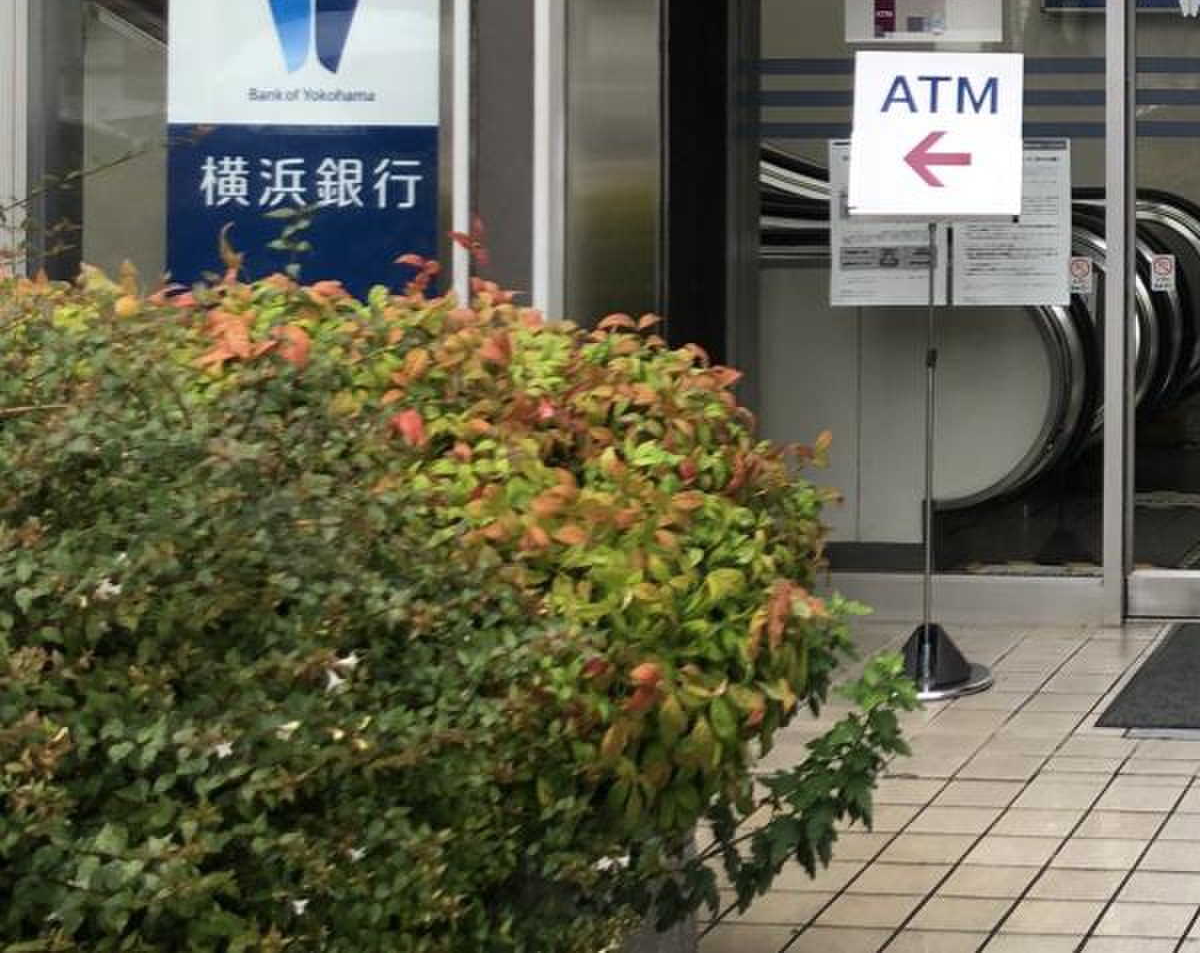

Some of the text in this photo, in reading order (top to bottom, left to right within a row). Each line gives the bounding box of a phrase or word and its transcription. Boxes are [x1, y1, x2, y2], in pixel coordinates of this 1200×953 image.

[248, 87, 376, 101] Bank of Yokohama
[880, 75, 999, 114] ATM
[199, 156, 423, 209] 横浜銀行
